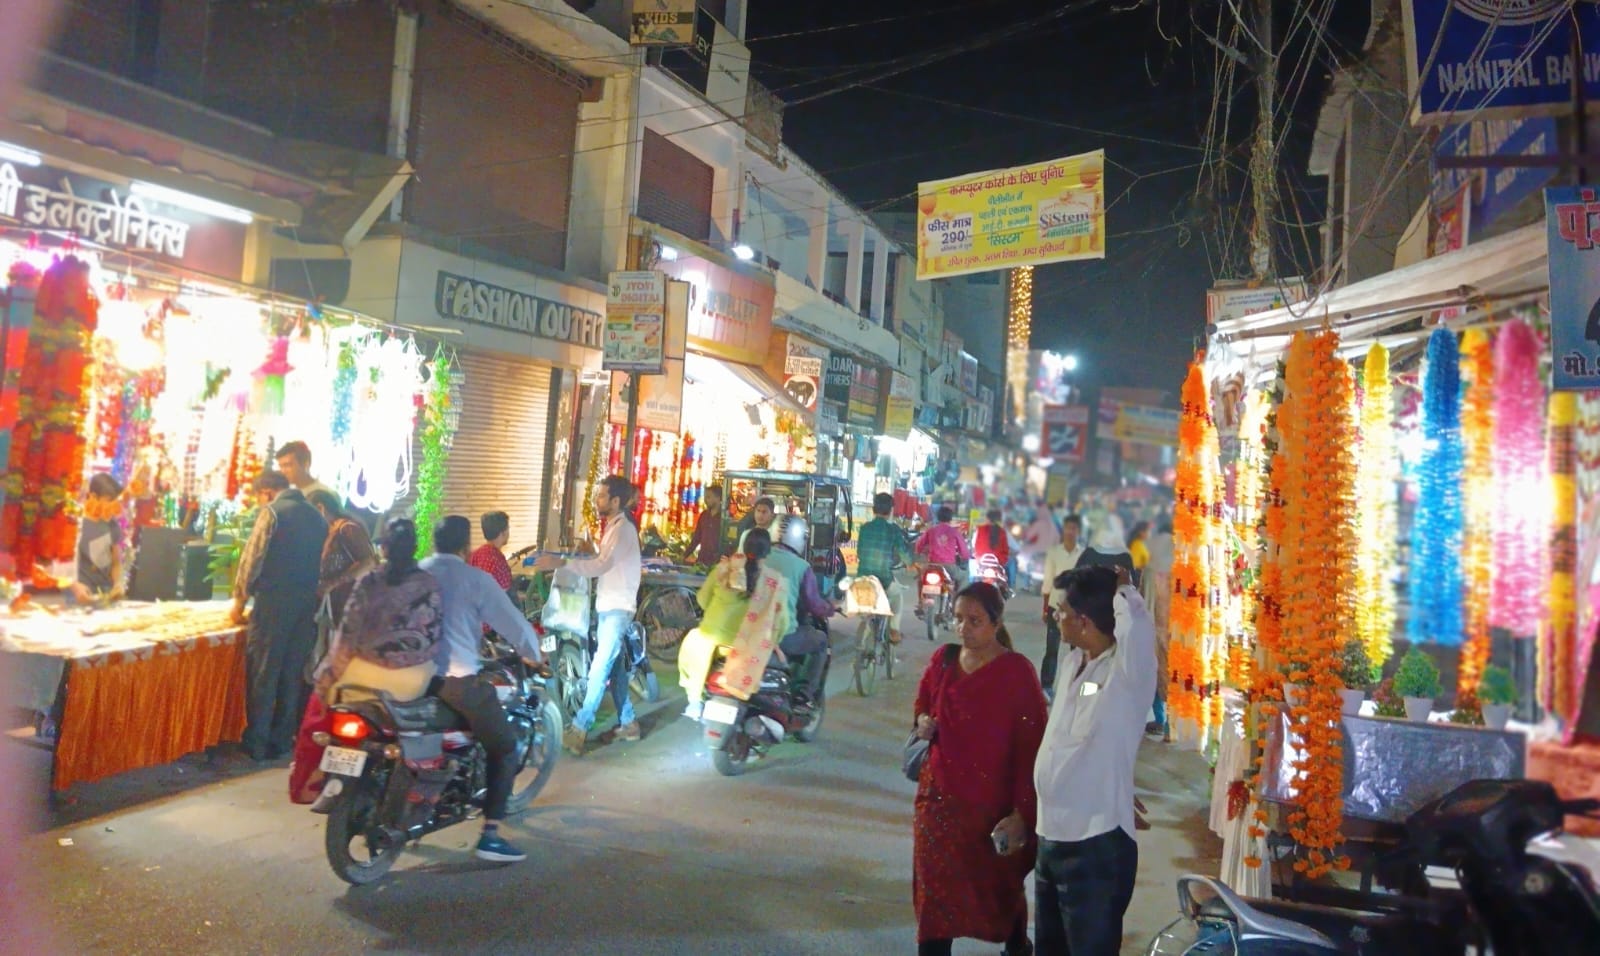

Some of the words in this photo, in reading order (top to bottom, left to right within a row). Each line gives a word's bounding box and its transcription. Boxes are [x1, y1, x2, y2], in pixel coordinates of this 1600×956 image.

[1438, 56, 1541, 93] NAINITAL
[1007, 173, 1017, 186] के
[1020, 168, 1037, 184] लिए
[952, 217, 972, 229] मात्र
[442, 277, 537, 332] FASHION
